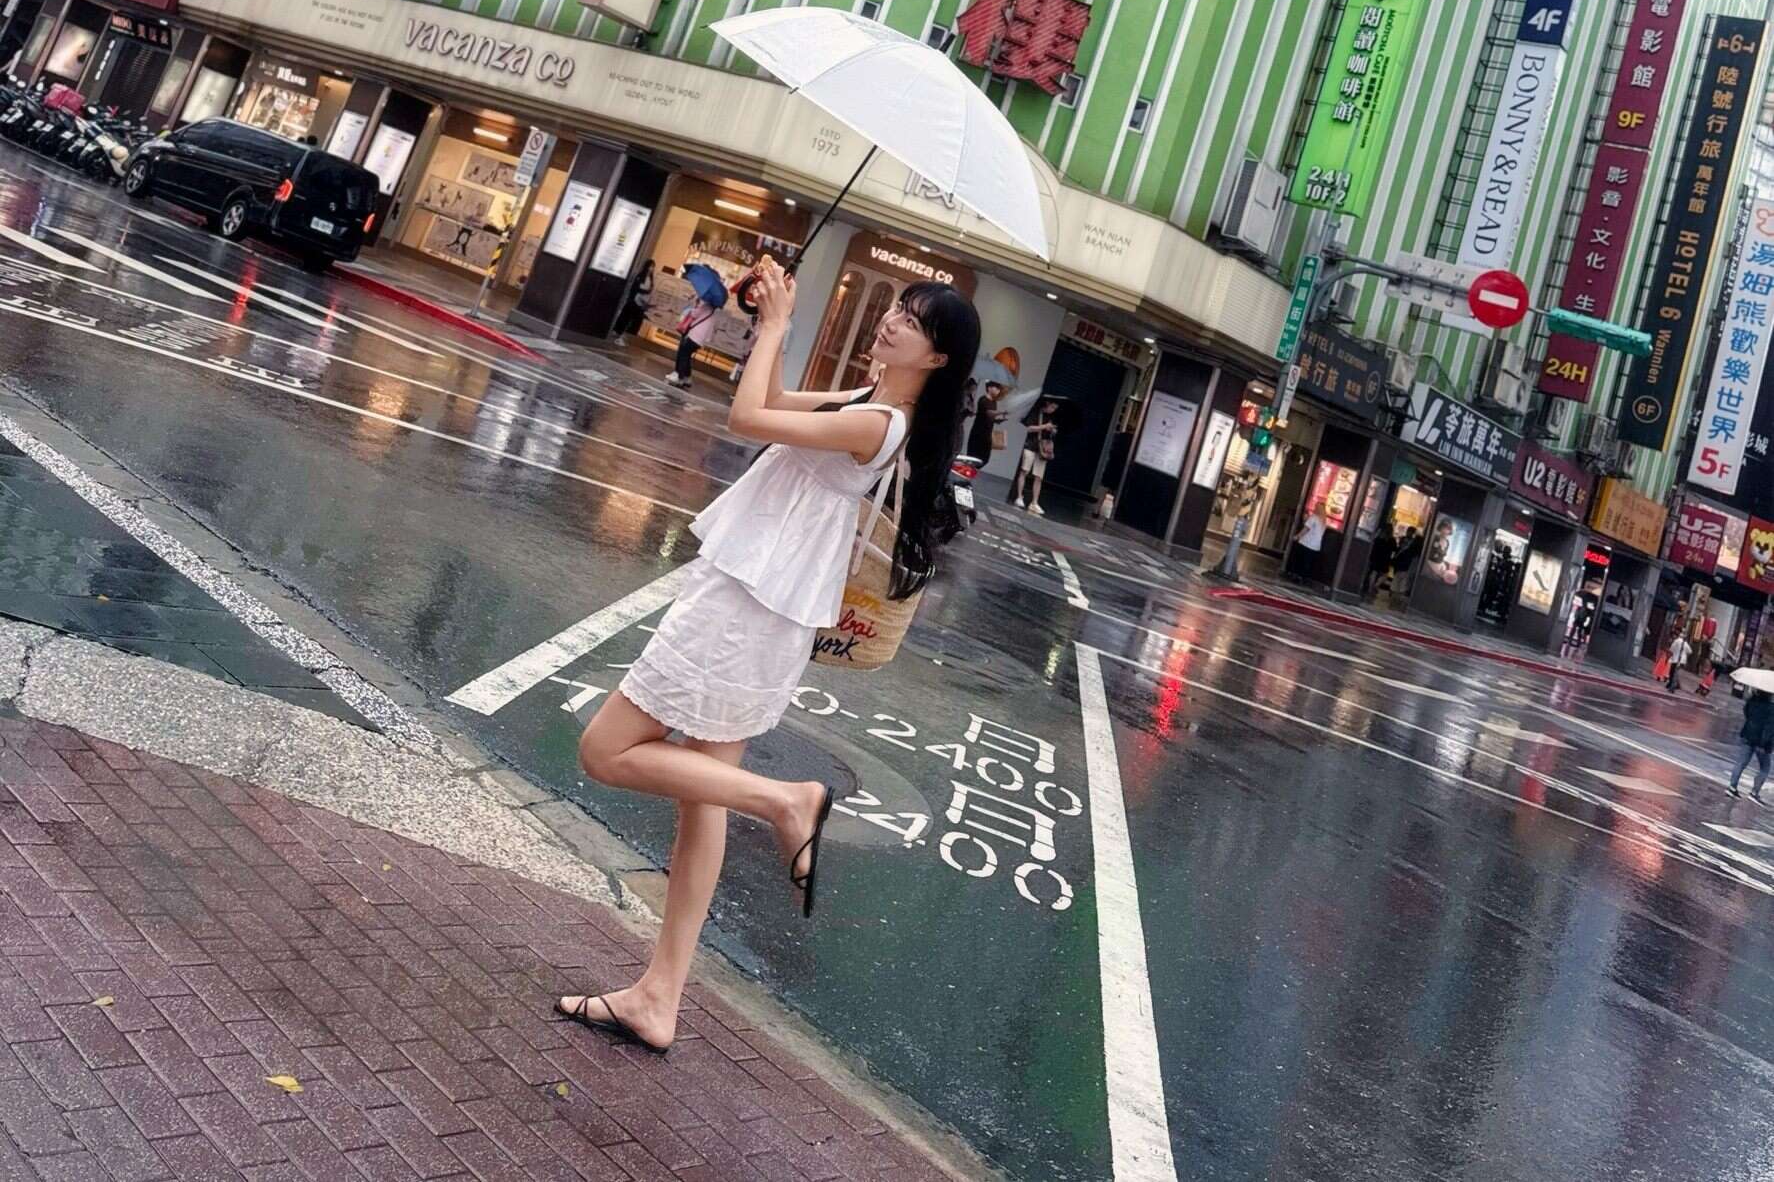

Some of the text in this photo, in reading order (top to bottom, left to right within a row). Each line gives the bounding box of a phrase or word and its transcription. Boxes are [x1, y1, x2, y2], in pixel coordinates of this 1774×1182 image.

[1527, 8, 1562, 32] 4F
[405, 18, 533, 76] vacanza
[1332, 5, 1384, 123] 閱讀咖啡館
[1617, 111, 1645, 128] 9F
[1699, 66, 1740, 159] 陸號行旅
[811, 137, 841, 156] 1973
[871, 246, 934, 278] vacanza
[1664, 230, 1700, 300] HOTEL
[1545, 358, 1588, 384] 24H
[1637, 404, 1656, 416] 6F
[1523, 456, 1546, 489] U2
[1696, 447, 1733, 480] 5F
[1680, 513, 1722, 538] U2
